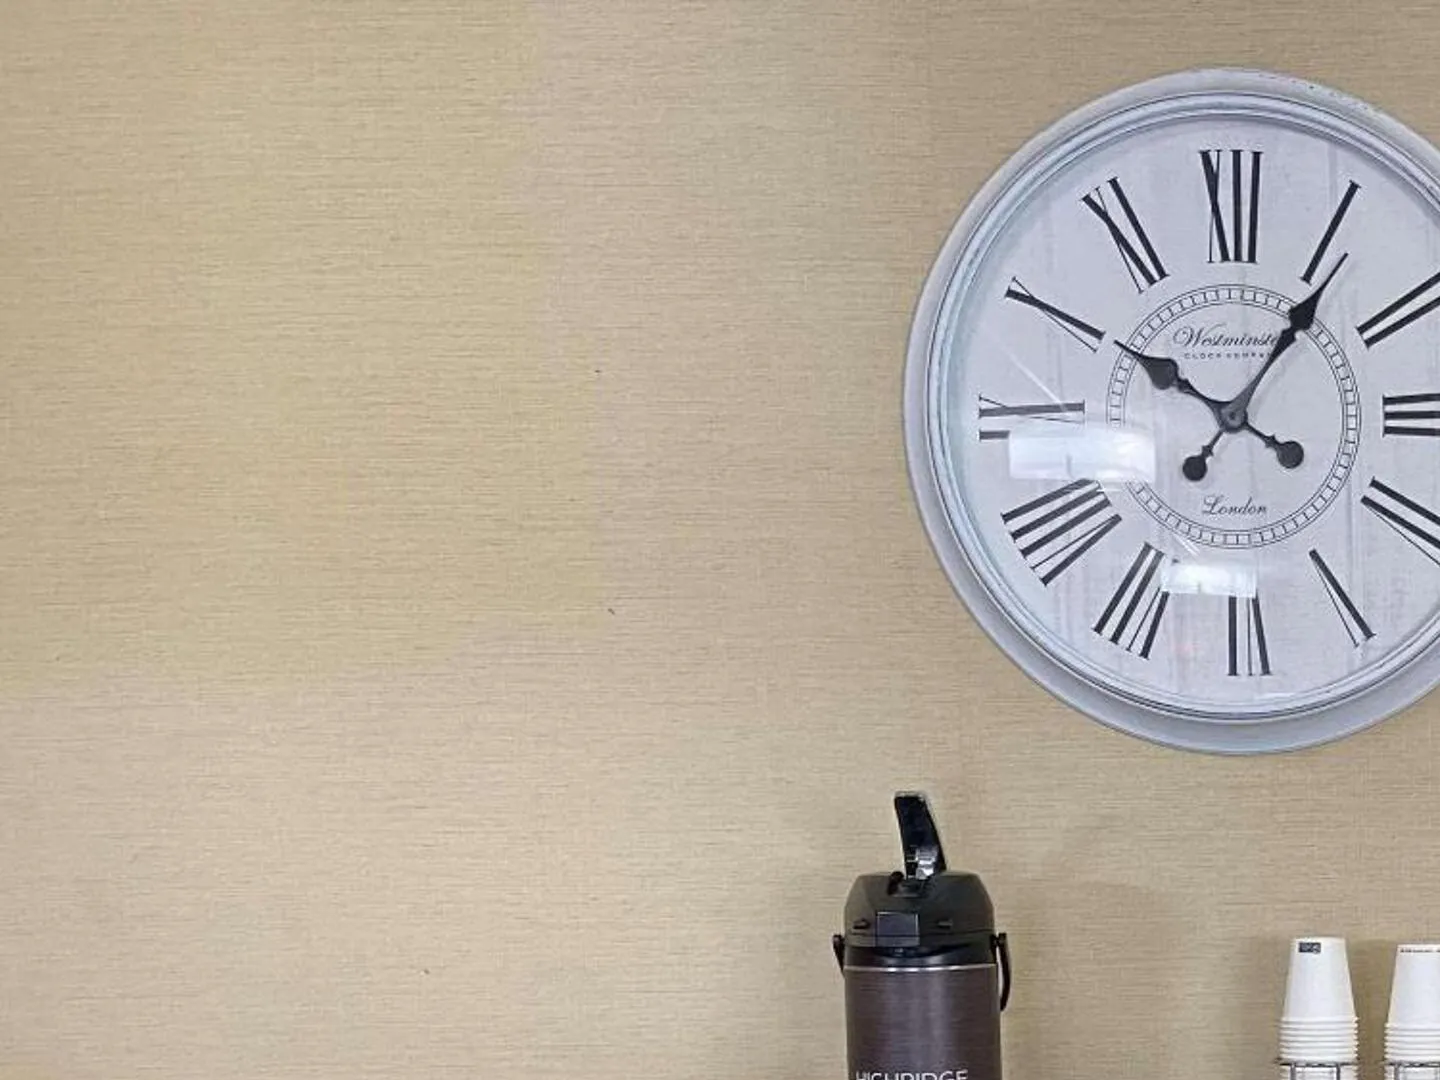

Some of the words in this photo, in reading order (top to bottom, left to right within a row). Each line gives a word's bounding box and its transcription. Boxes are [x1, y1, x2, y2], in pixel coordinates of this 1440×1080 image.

[1199, 149, 1263, 265] XII
[1173, 322, 1280, 348] Westminste
[1202, 494, 1267, 515] London
